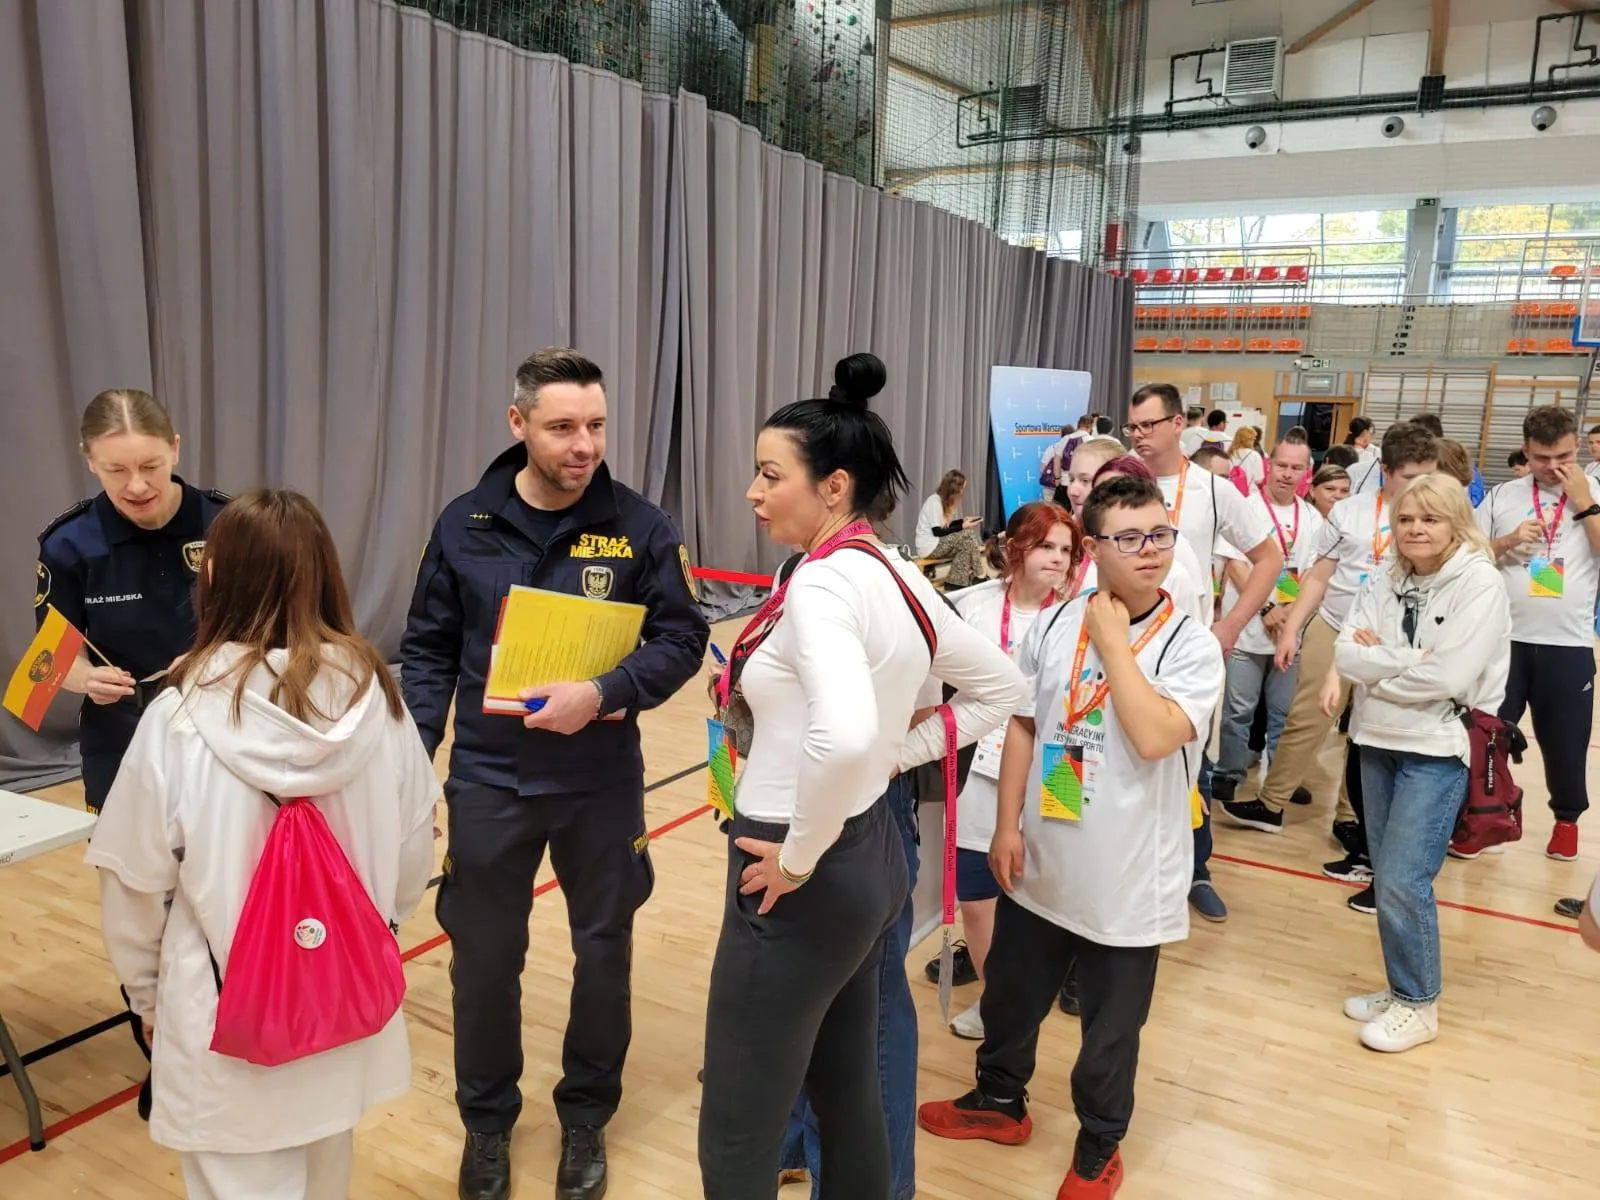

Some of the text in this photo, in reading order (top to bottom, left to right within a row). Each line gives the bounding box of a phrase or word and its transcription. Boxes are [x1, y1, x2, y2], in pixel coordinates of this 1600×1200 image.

[1015, 422, 1063, 432] Sportowa Warsza
[580, 533, 629, 548] STRAŻ
[570, 545, 633, 558] MIEJSKA
[106, 593, 143, 602] MIEJSKA
[1057, 721, 1104, 742] INGRACYJNY
